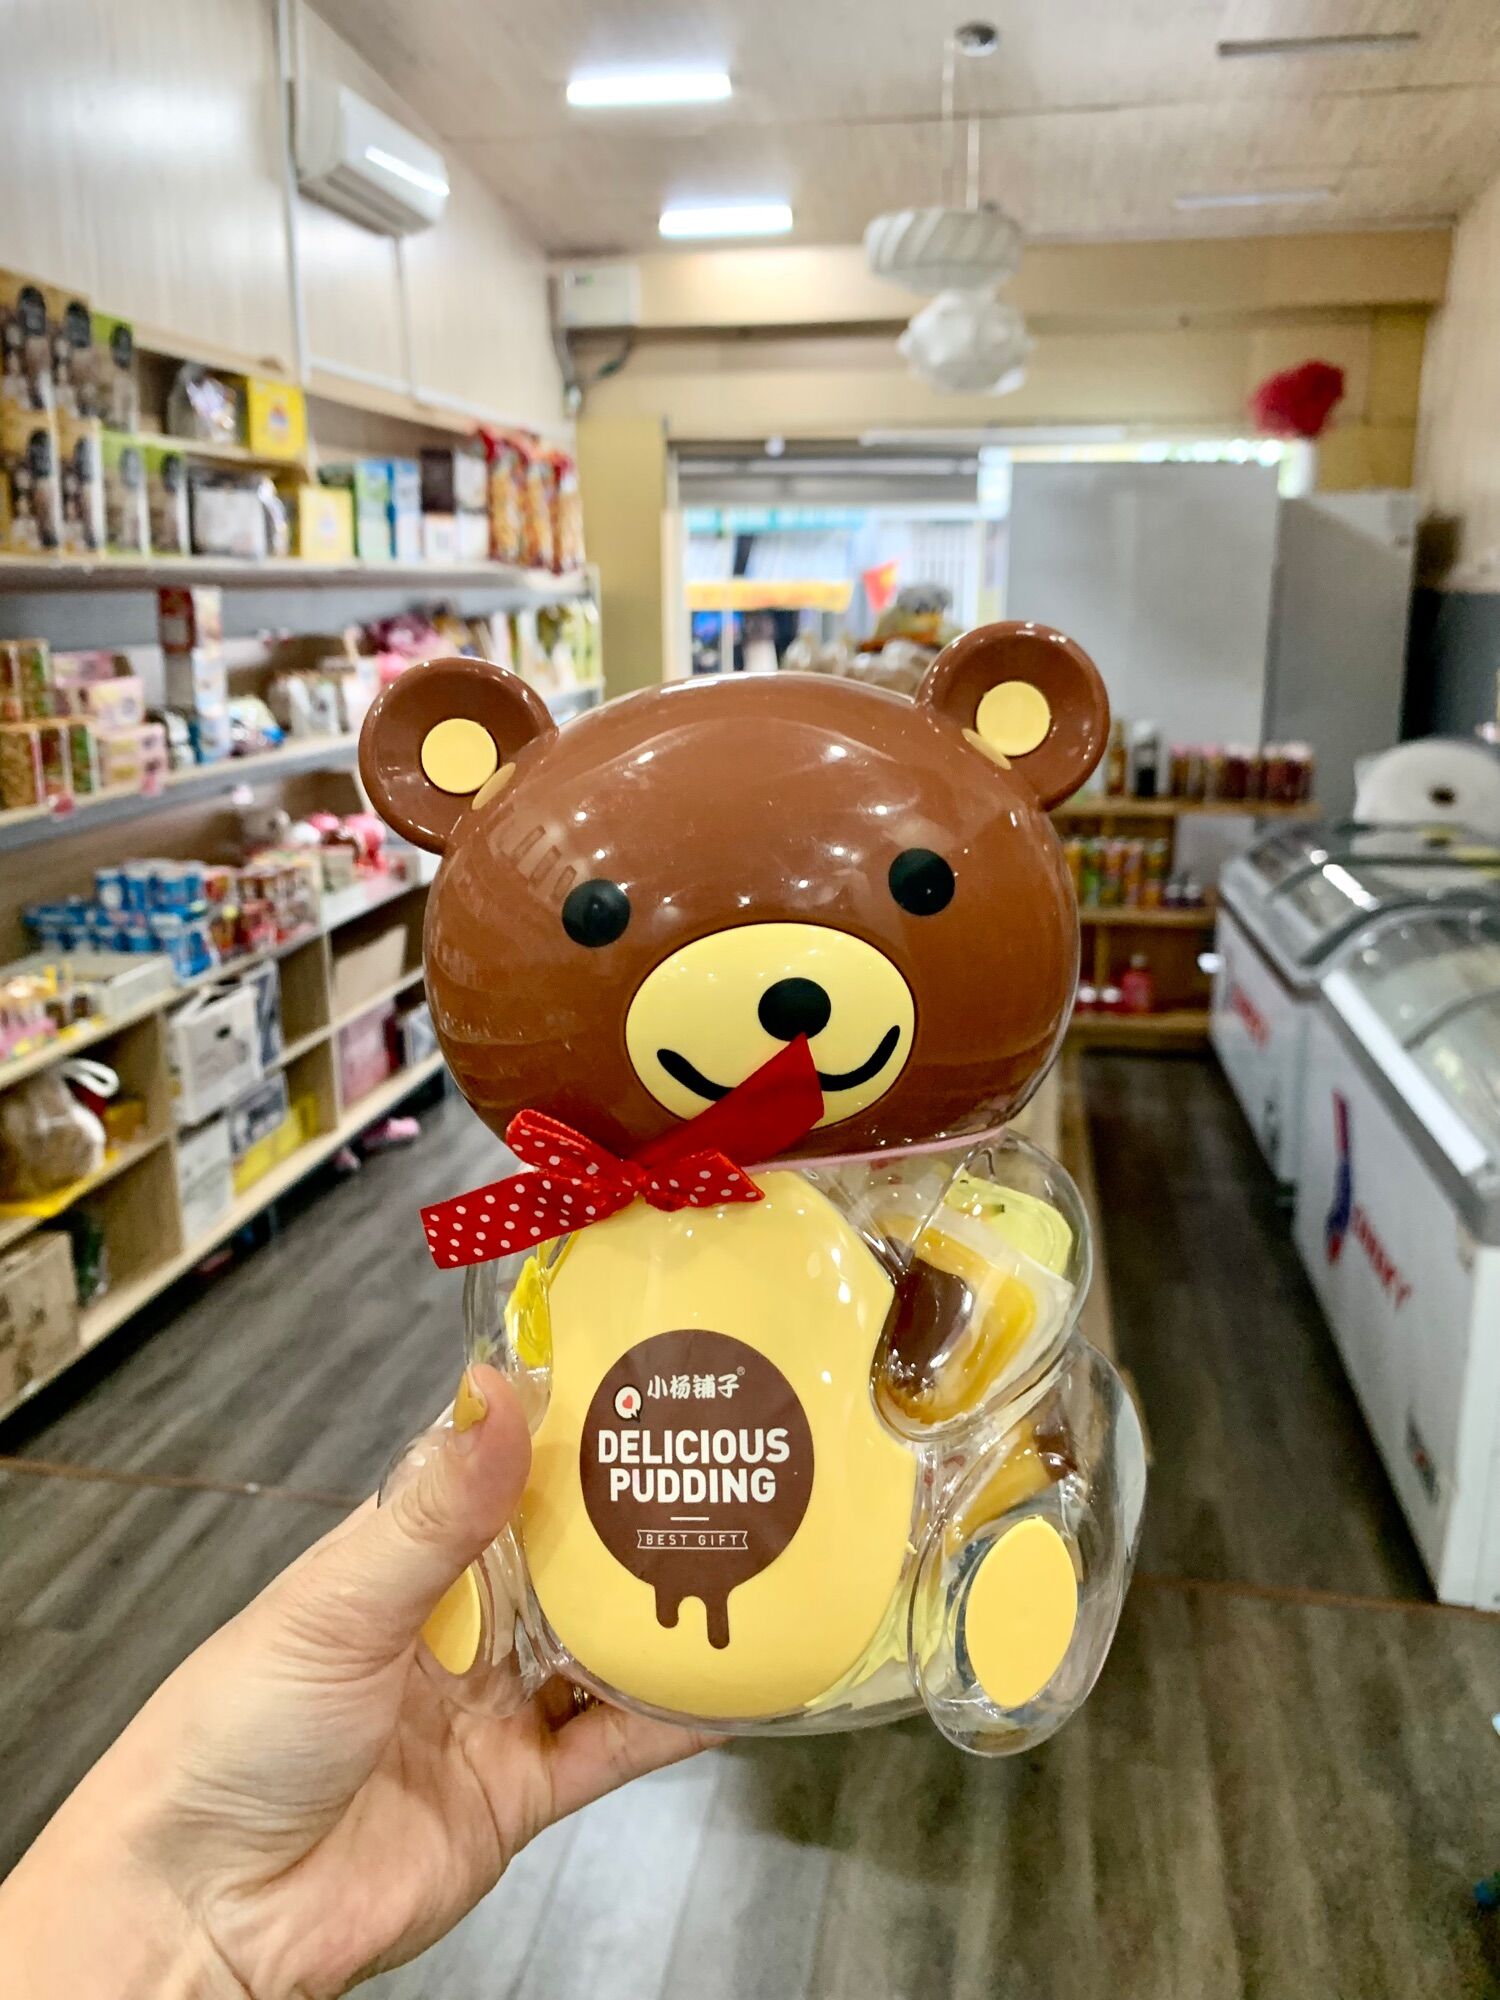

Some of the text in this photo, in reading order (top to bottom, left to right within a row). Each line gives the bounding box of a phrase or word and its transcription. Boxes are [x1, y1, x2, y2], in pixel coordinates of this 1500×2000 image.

[647, 1373, 740, 1400] 小杨铺子
[598, 1428, 790, 1465] DELICIOUS
[610, 1467, 776, 1504] PUDDING
[646, 1534, 738, 1547] BEST GIFT
